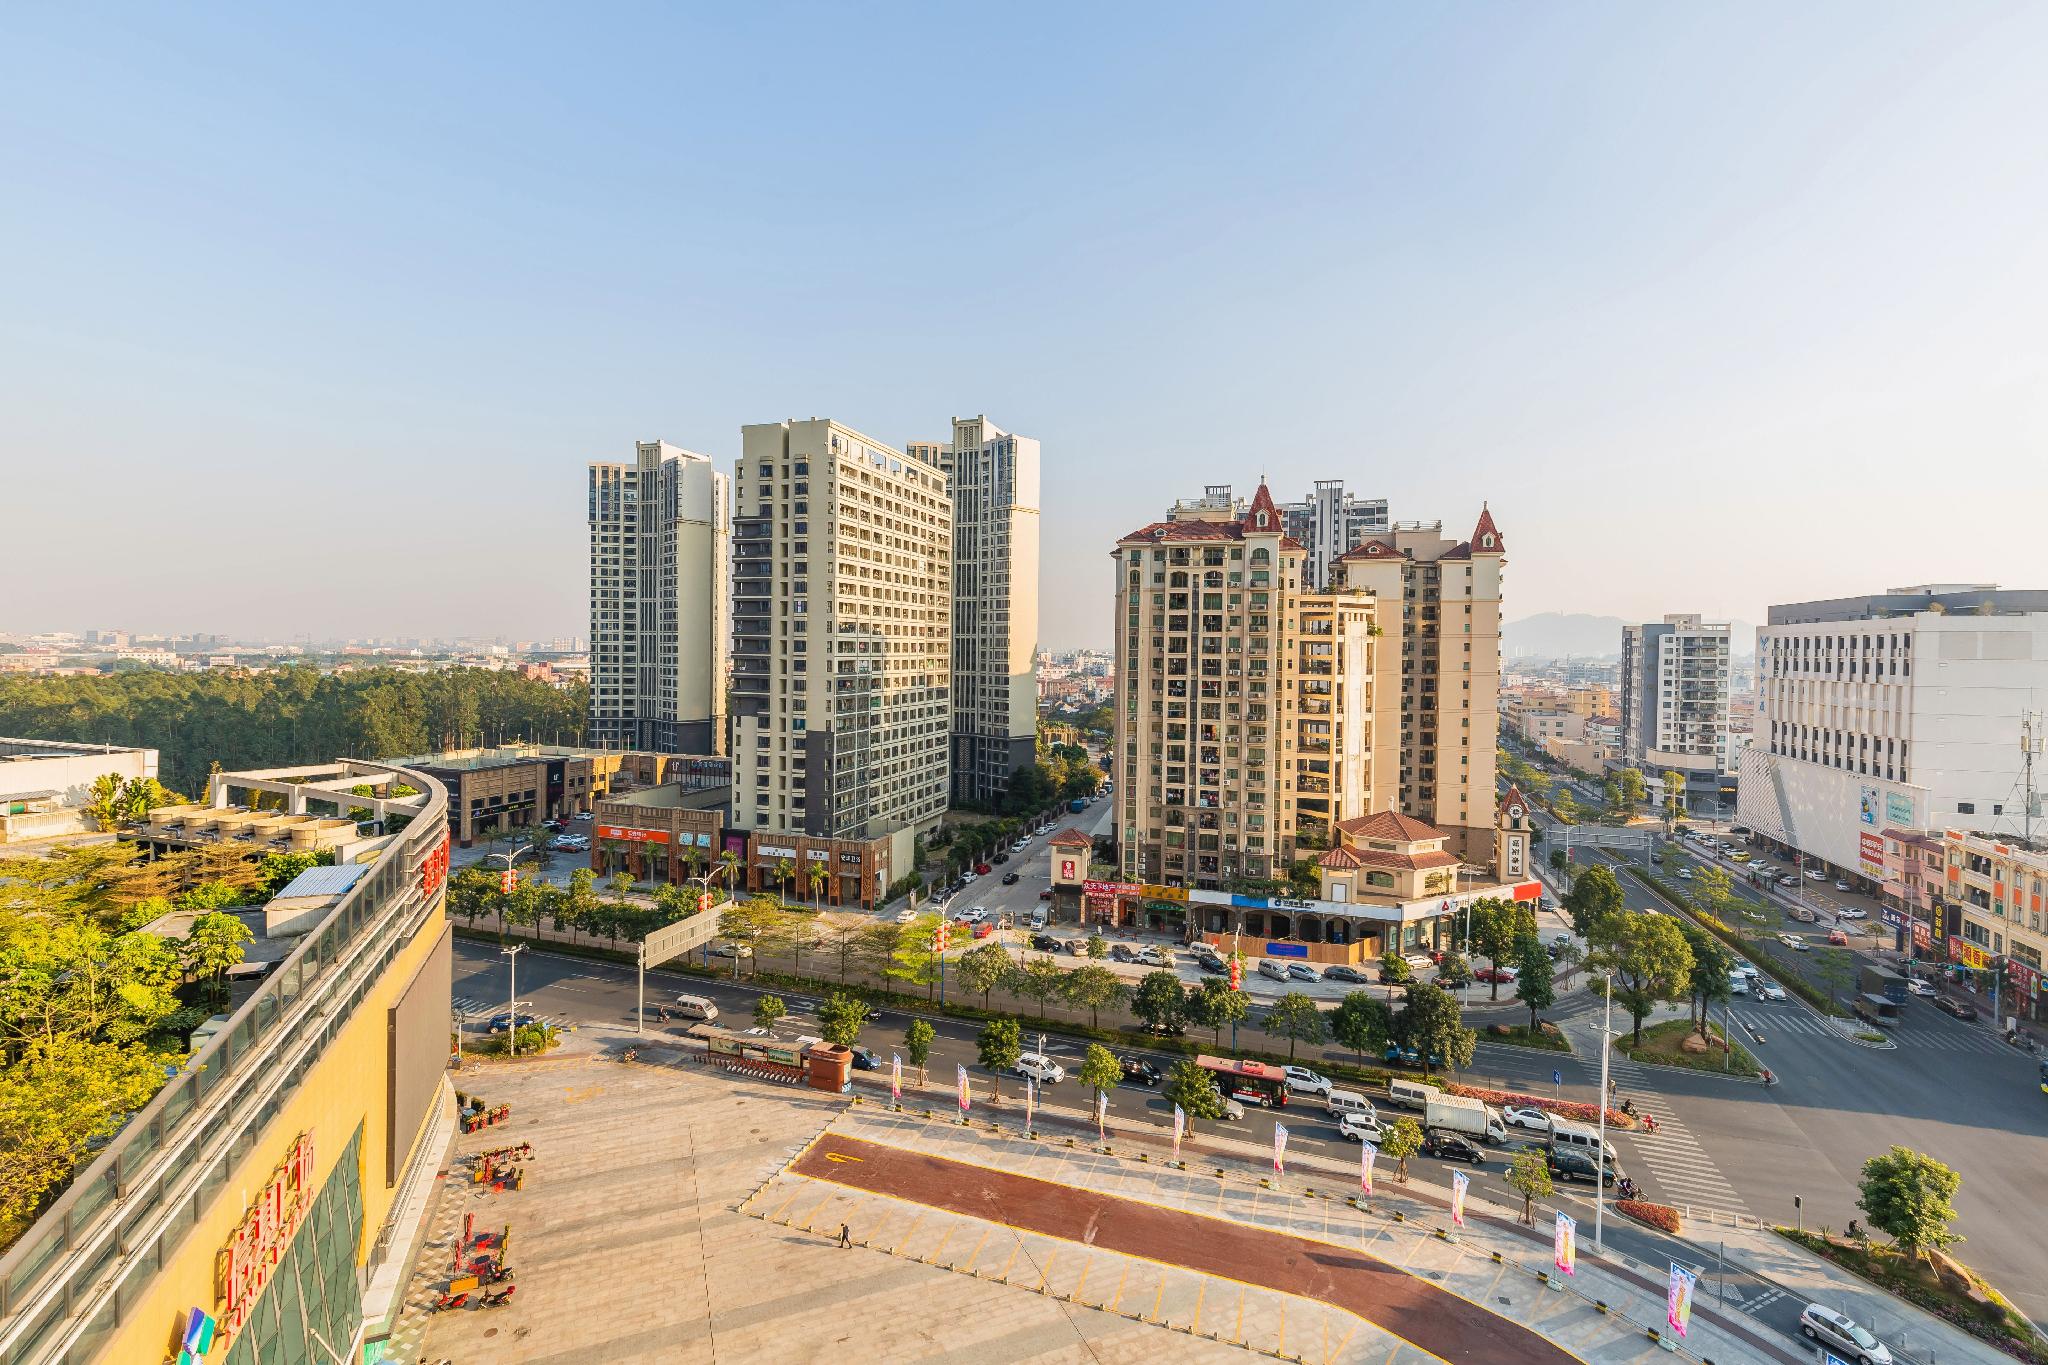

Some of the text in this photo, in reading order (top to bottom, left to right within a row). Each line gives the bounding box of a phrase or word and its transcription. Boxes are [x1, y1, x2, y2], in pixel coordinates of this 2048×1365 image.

[1083, 882, 1116, 893] 众天下地产
